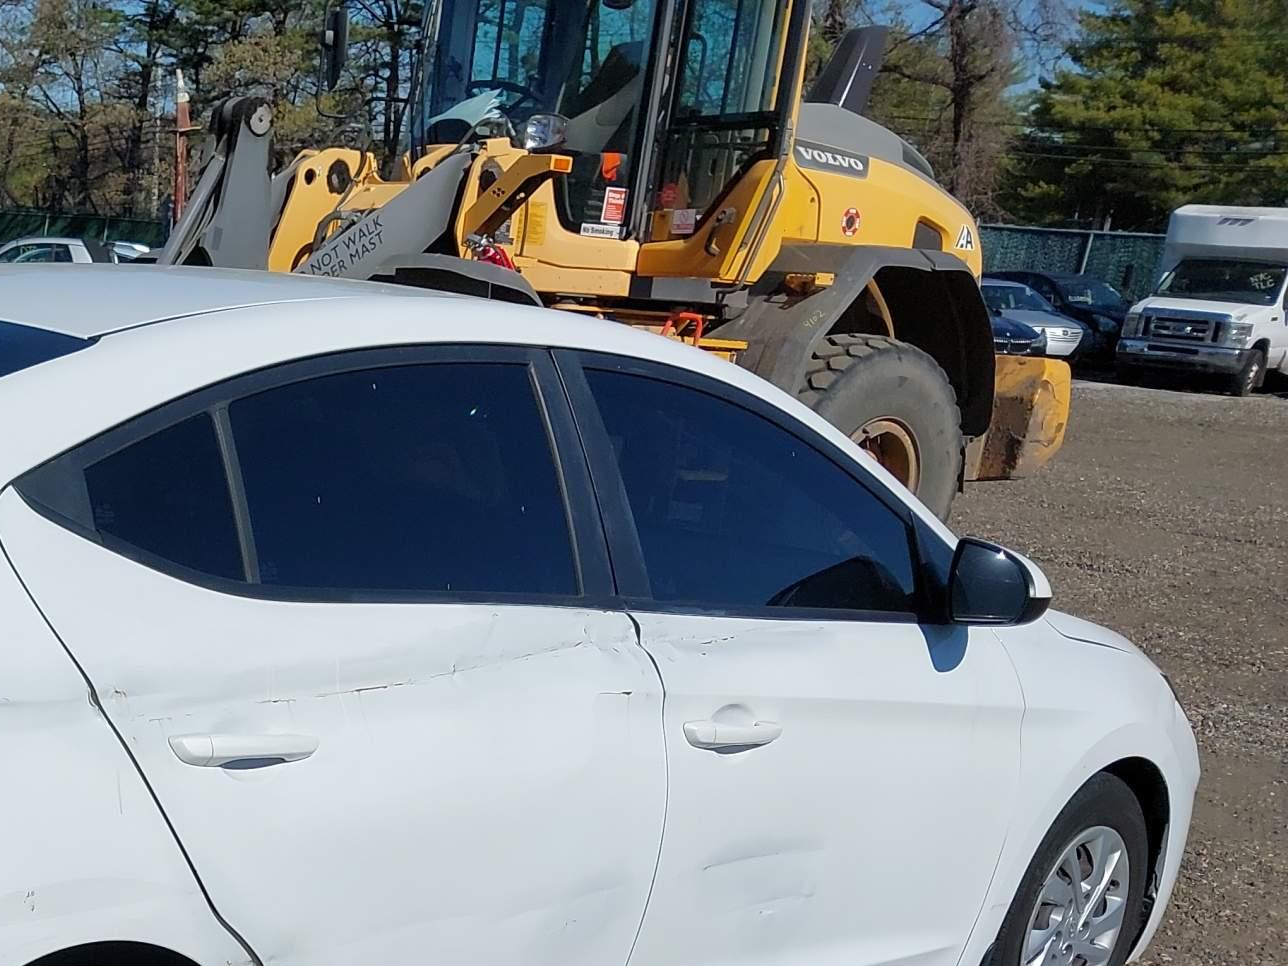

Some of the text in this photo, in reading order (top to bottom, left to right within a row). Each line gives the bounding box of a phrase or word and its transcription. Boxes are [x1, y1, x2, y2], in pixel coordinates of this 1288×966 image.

[796, 145, 864, 171] VOLVO
[310, 215, 384, 275] NOT WALK
[349, 230, 384, 265] MAST
